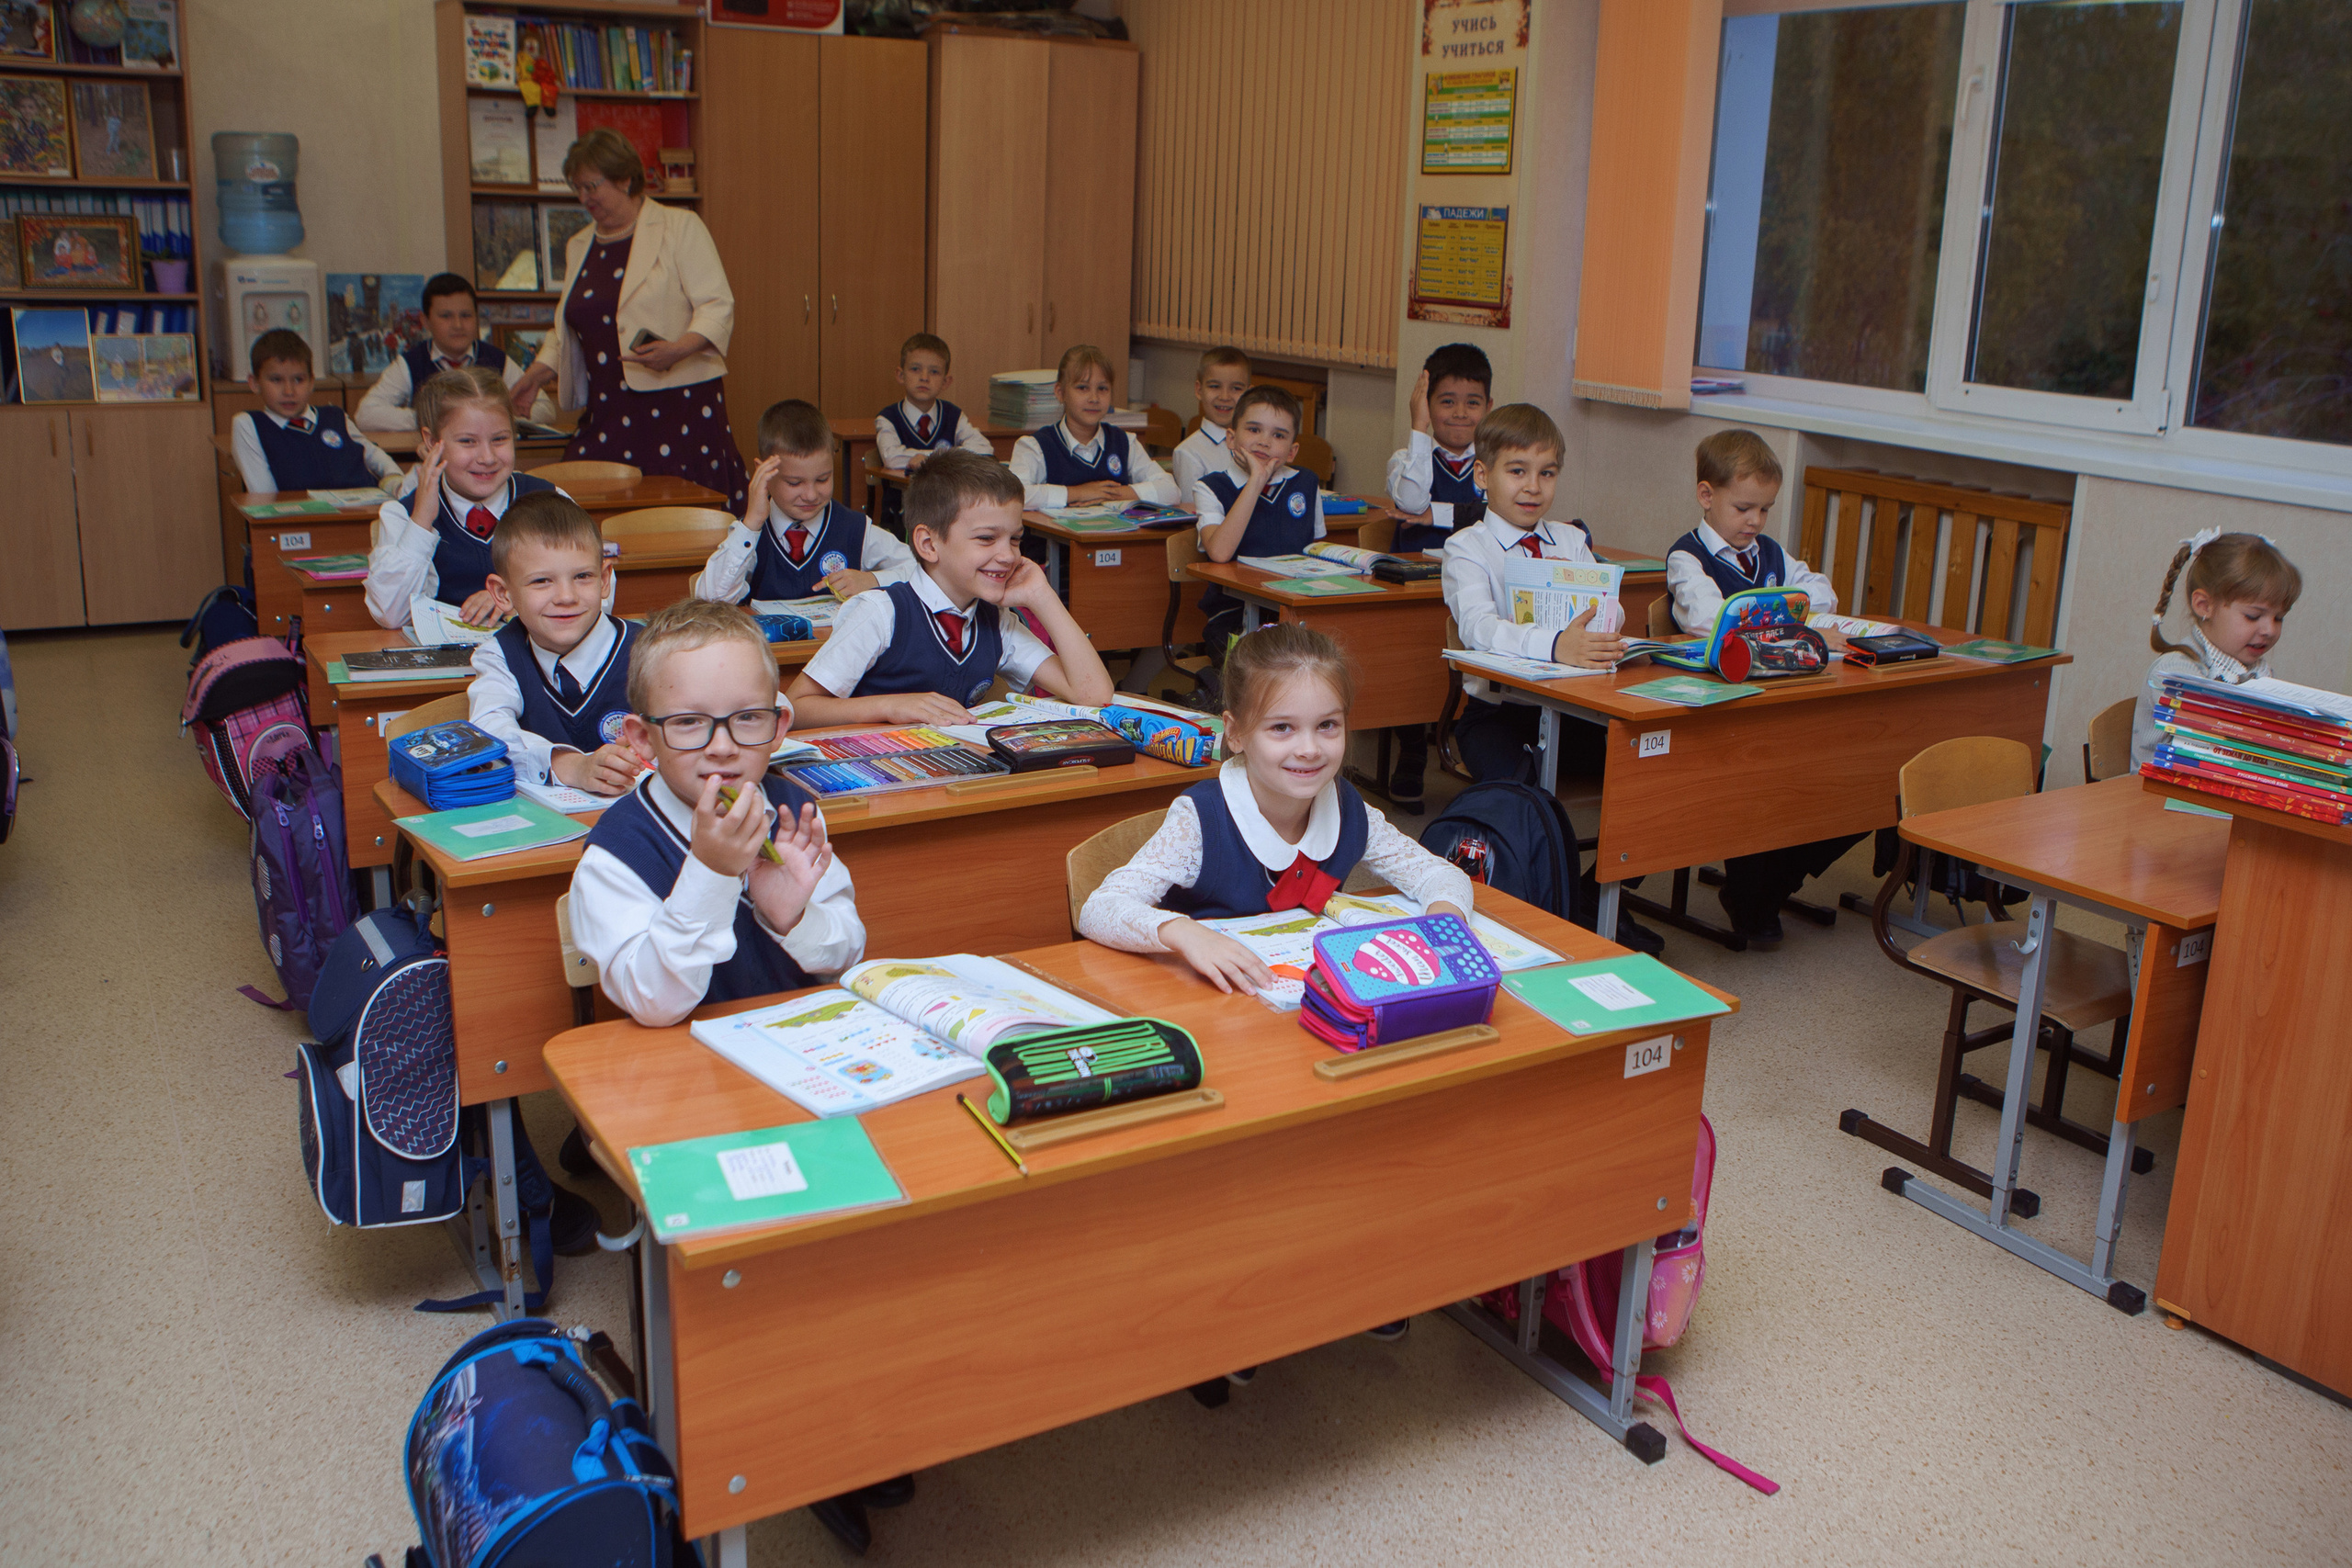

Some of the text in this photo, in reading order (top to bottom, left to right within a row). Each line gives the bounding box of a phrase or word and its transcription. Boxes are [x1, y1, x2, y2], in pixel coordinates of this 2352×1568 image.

[1452, 16, 1498, 34] УЧИСЬ
[1442, 39, 1505, 58] УЧИТЬСЯ
[1443, 207, 1485, 220] ПАДЕЖИ
[283, 535, 305, 547] 104
[1099, 552, 1116, 563] 104
[1644, 735, 1665, 750] 104
[2222, 750, 2242, 759] ЗЕМЛИ
[2252, 756, 2268, 764] НЕБА
[2236, 772, 2257, 780] РУССКИЙ
[2256, 776, 2276, 784] РОДНОЙ
[2184, 940, 2205, 959] 104
[1632, 1045, 1663, 1069] 104
